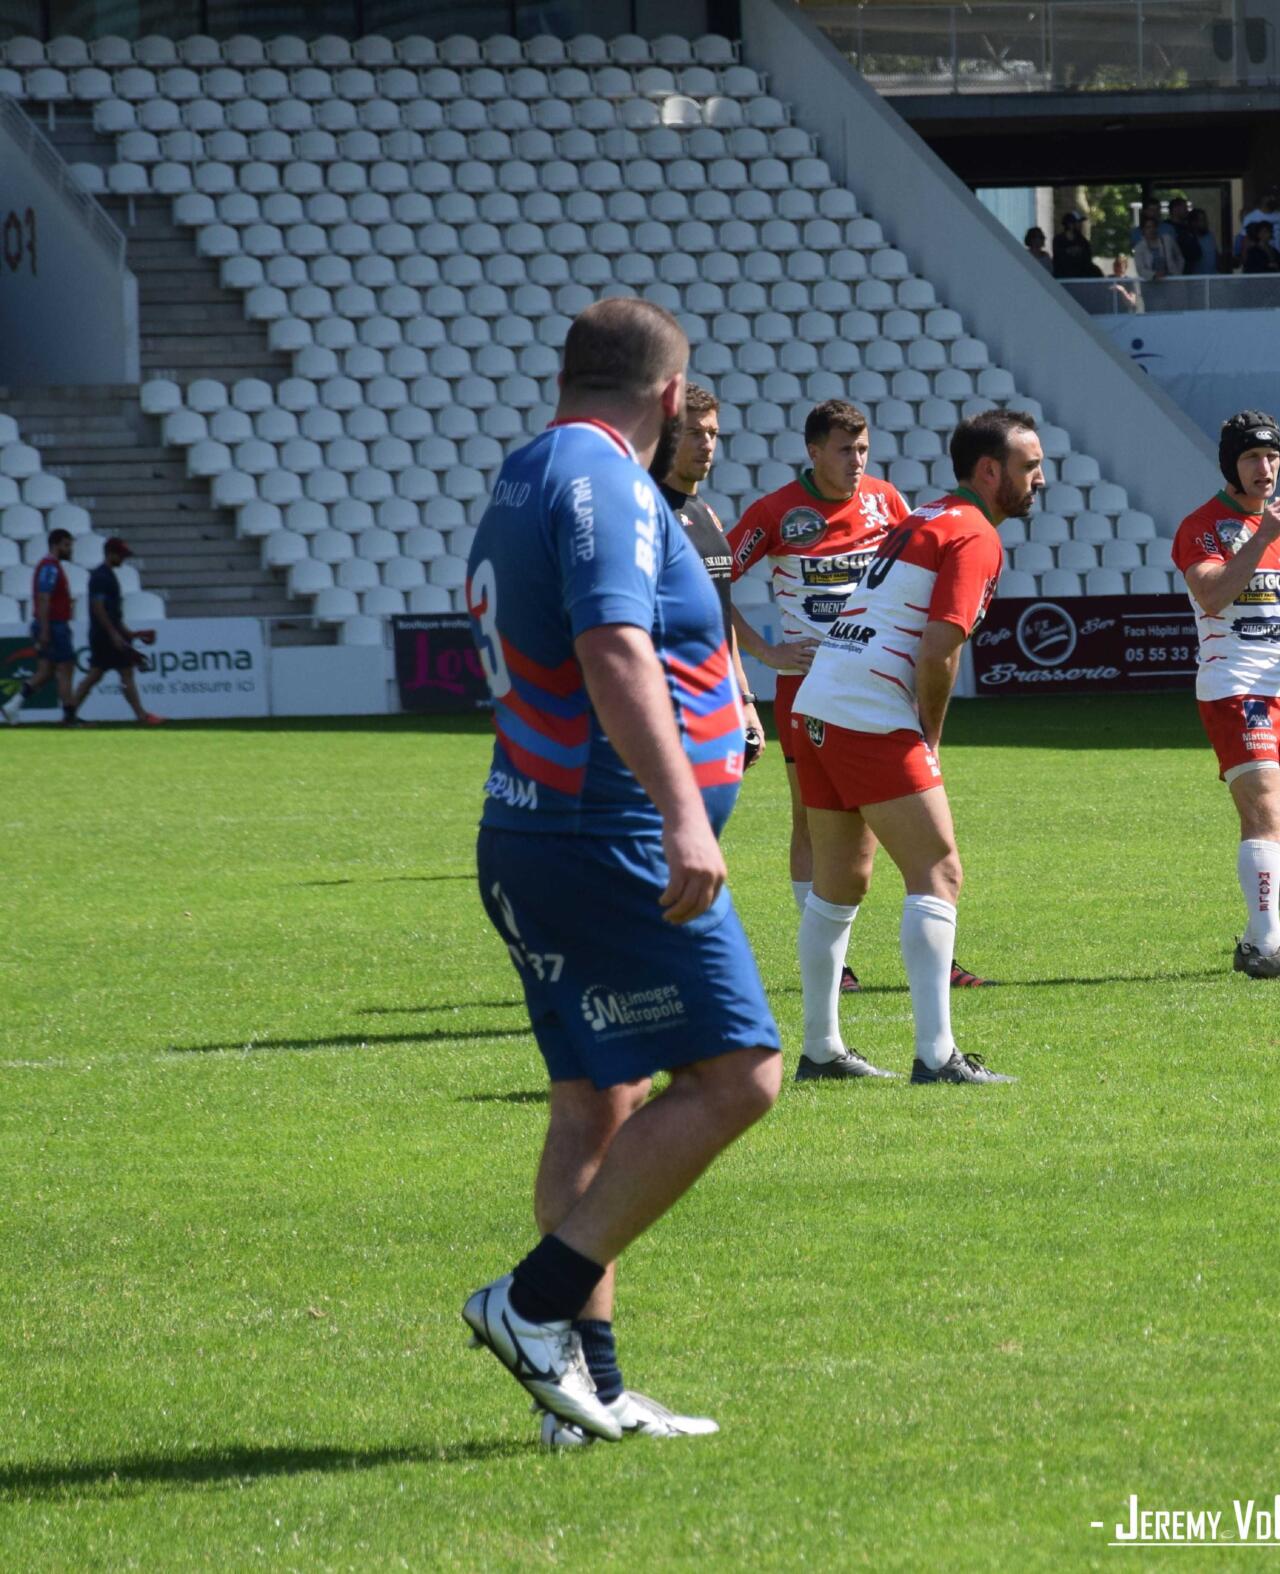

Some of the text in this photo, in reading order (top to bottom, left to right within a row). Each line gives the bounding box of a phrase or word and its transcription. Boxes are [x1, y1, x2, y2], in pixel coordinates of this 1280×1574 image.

[827, 621, 877, 643] ALKAR
[74, 647, 253, 677] Gupama
[1125, 647, 1145, 661] 05
[1149, 647, 1167, 661] 55
[1171, 646, 1189, 660] 33
[980, 663, 1120, 685] Brasserie
